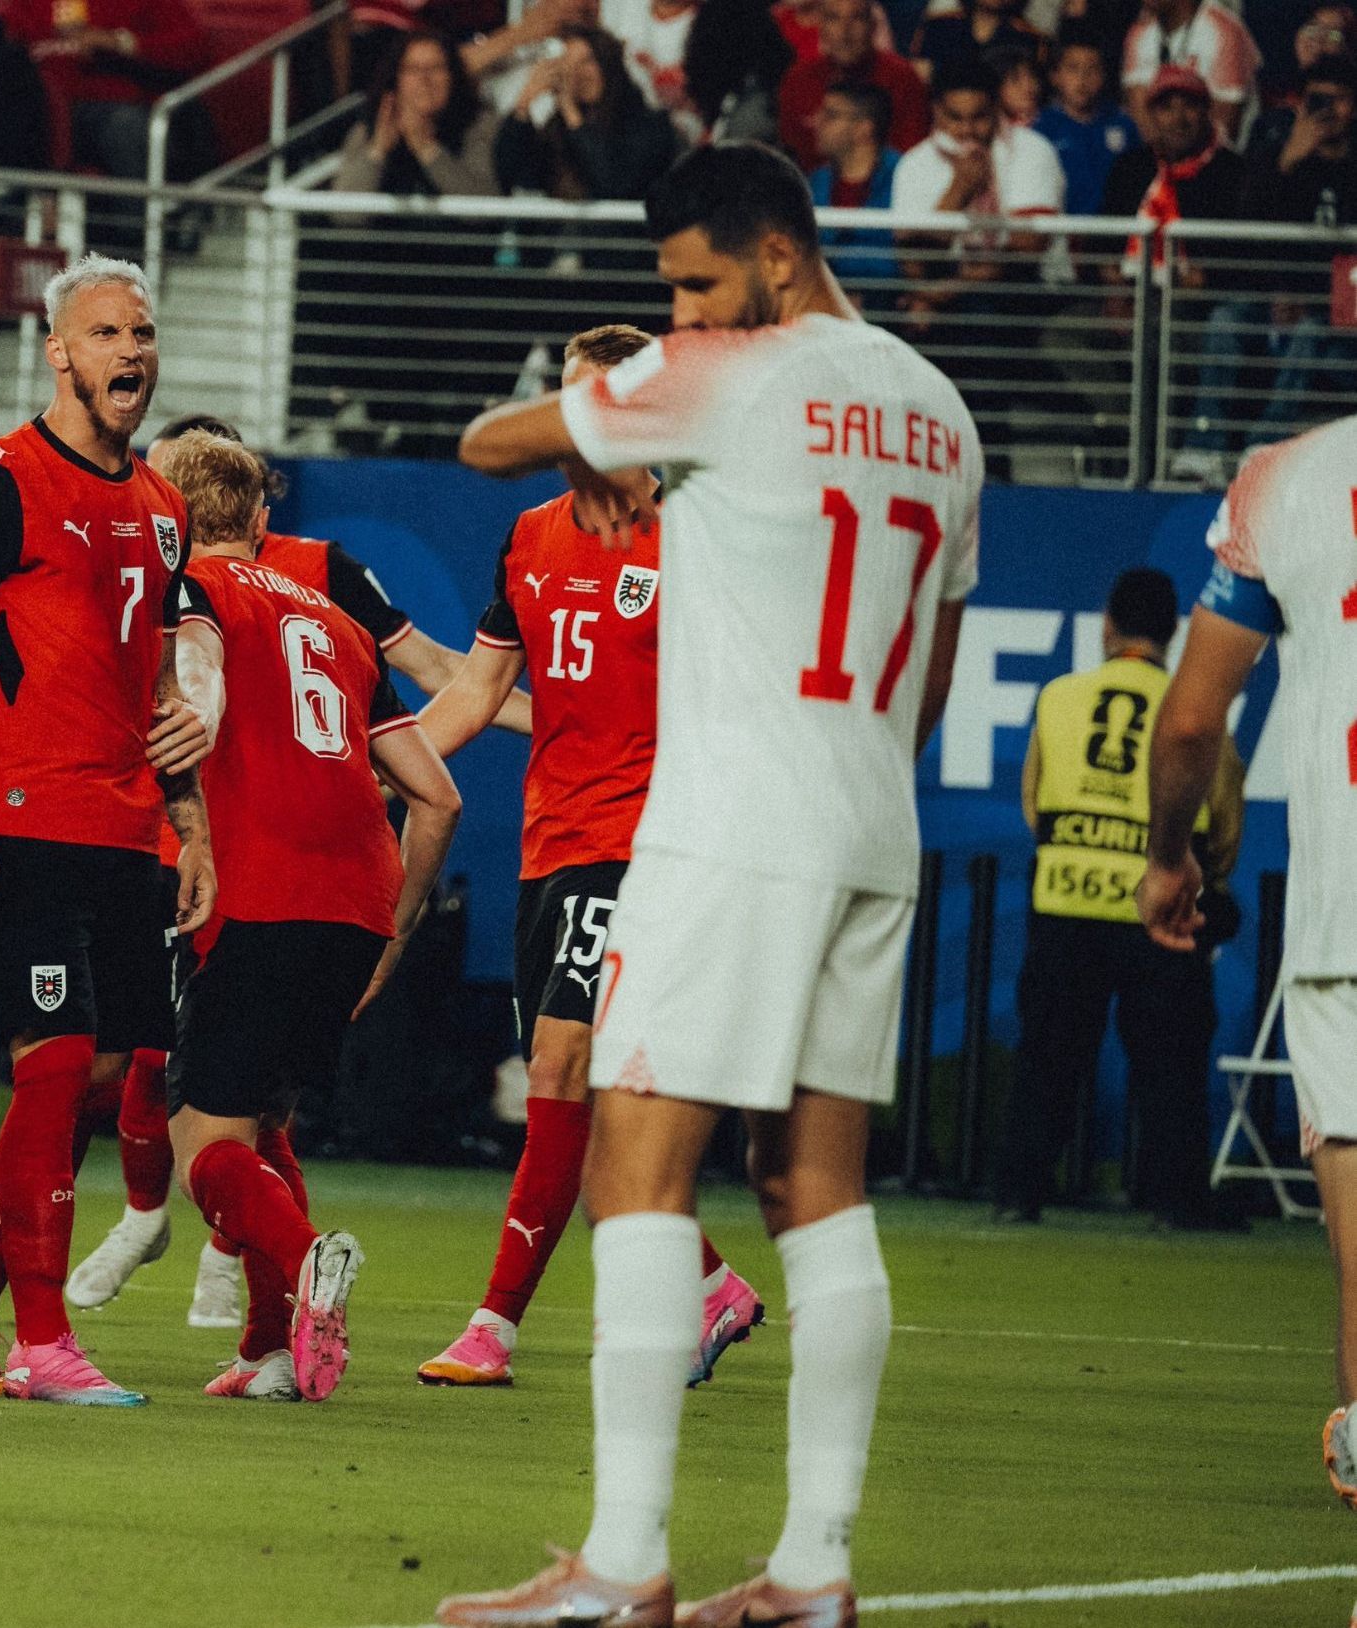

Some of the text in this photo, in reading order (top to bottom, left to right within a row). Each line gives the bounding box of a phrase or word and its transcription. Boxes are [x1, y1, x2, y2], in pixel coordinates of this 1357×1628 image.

[804, 399, 963, 483] SALEEM
[120, 566, 145, 645] 7
[798, 485, 944, 715] 17
[546, 607, 602, 683] 15
[279, 613, 353, 761] 6
[553, 894, 619, 968] 15
[51, 1189, 75, 1203] ÖF
